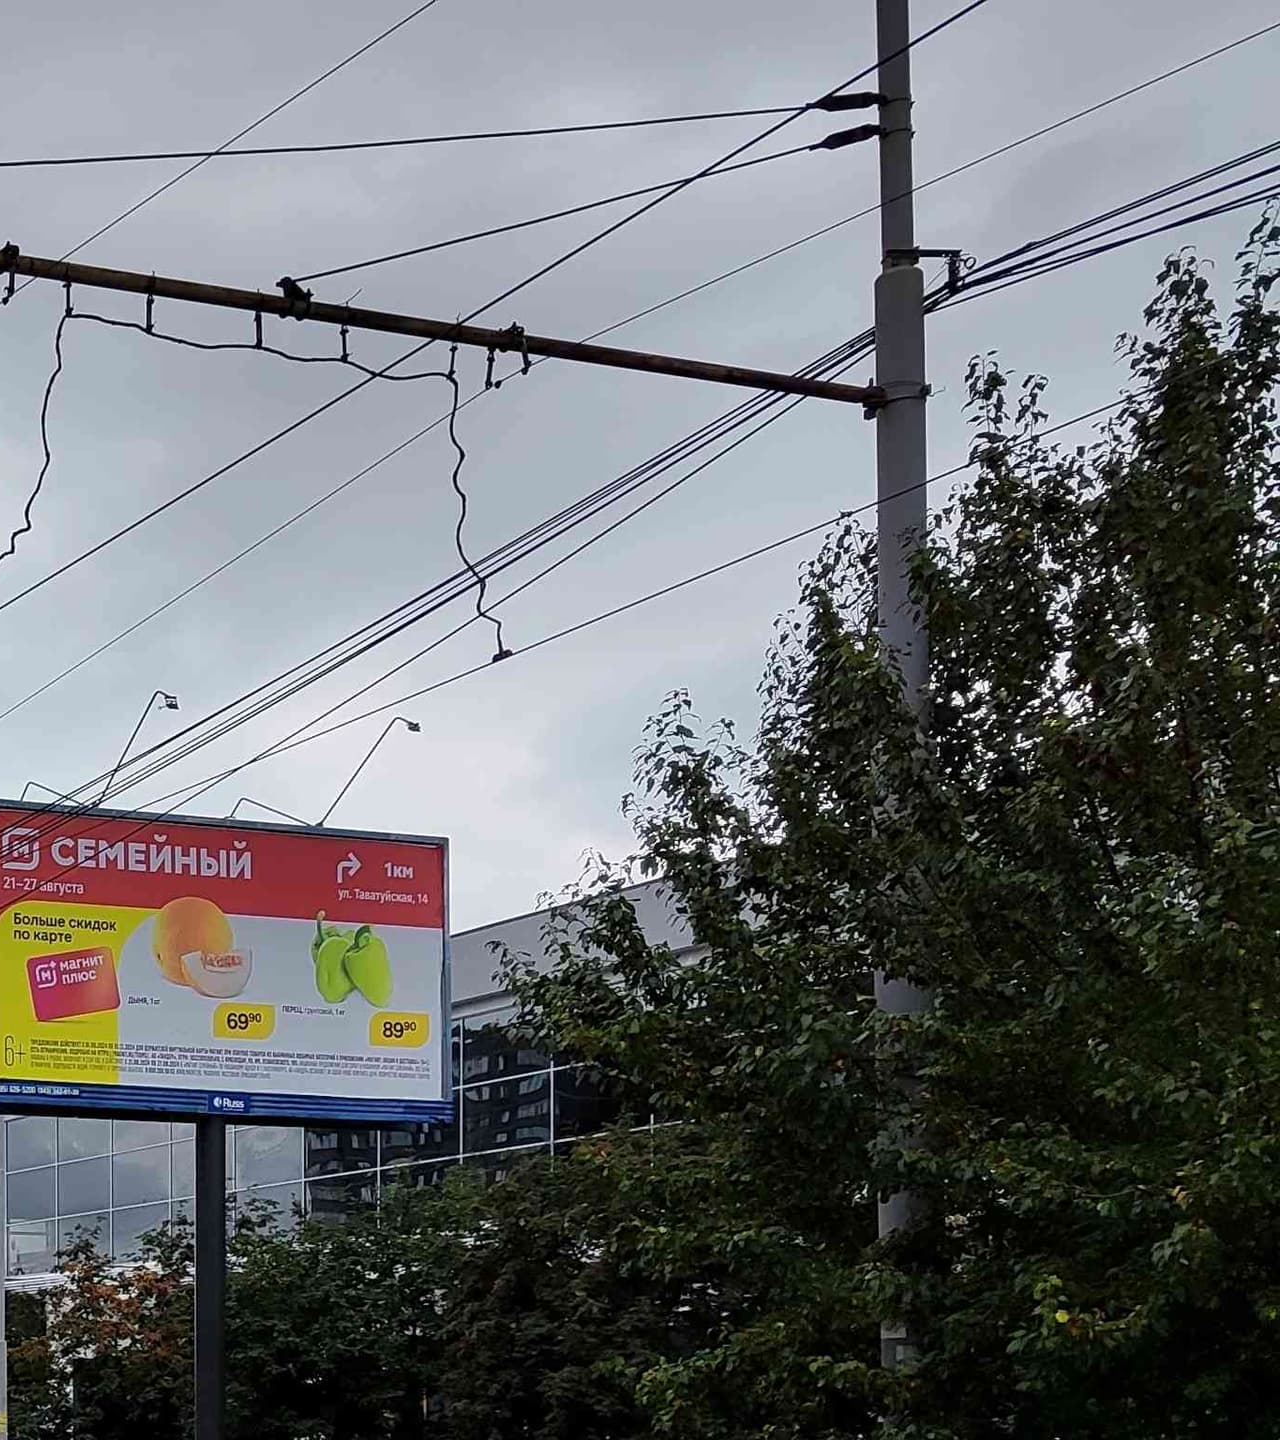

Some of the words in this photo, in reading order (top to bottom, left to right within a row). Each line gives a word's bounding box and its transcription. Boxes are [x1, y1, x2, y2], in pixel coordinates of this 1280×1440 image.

[51, 833, 252, 880] СЕМЕЙНЫЙ
[39, 881, 84, 896] августа
[418, 894, 429, 904] 14
[13, 912, 66, 928] Больше
[68, 919, 117, 933] скидок
[13, 930, 30, 940] по
[33, 931, 73, 944] карте
[4, 1035, 26, 1067] 6+
[223, 1097, 245, 1109] Russ
